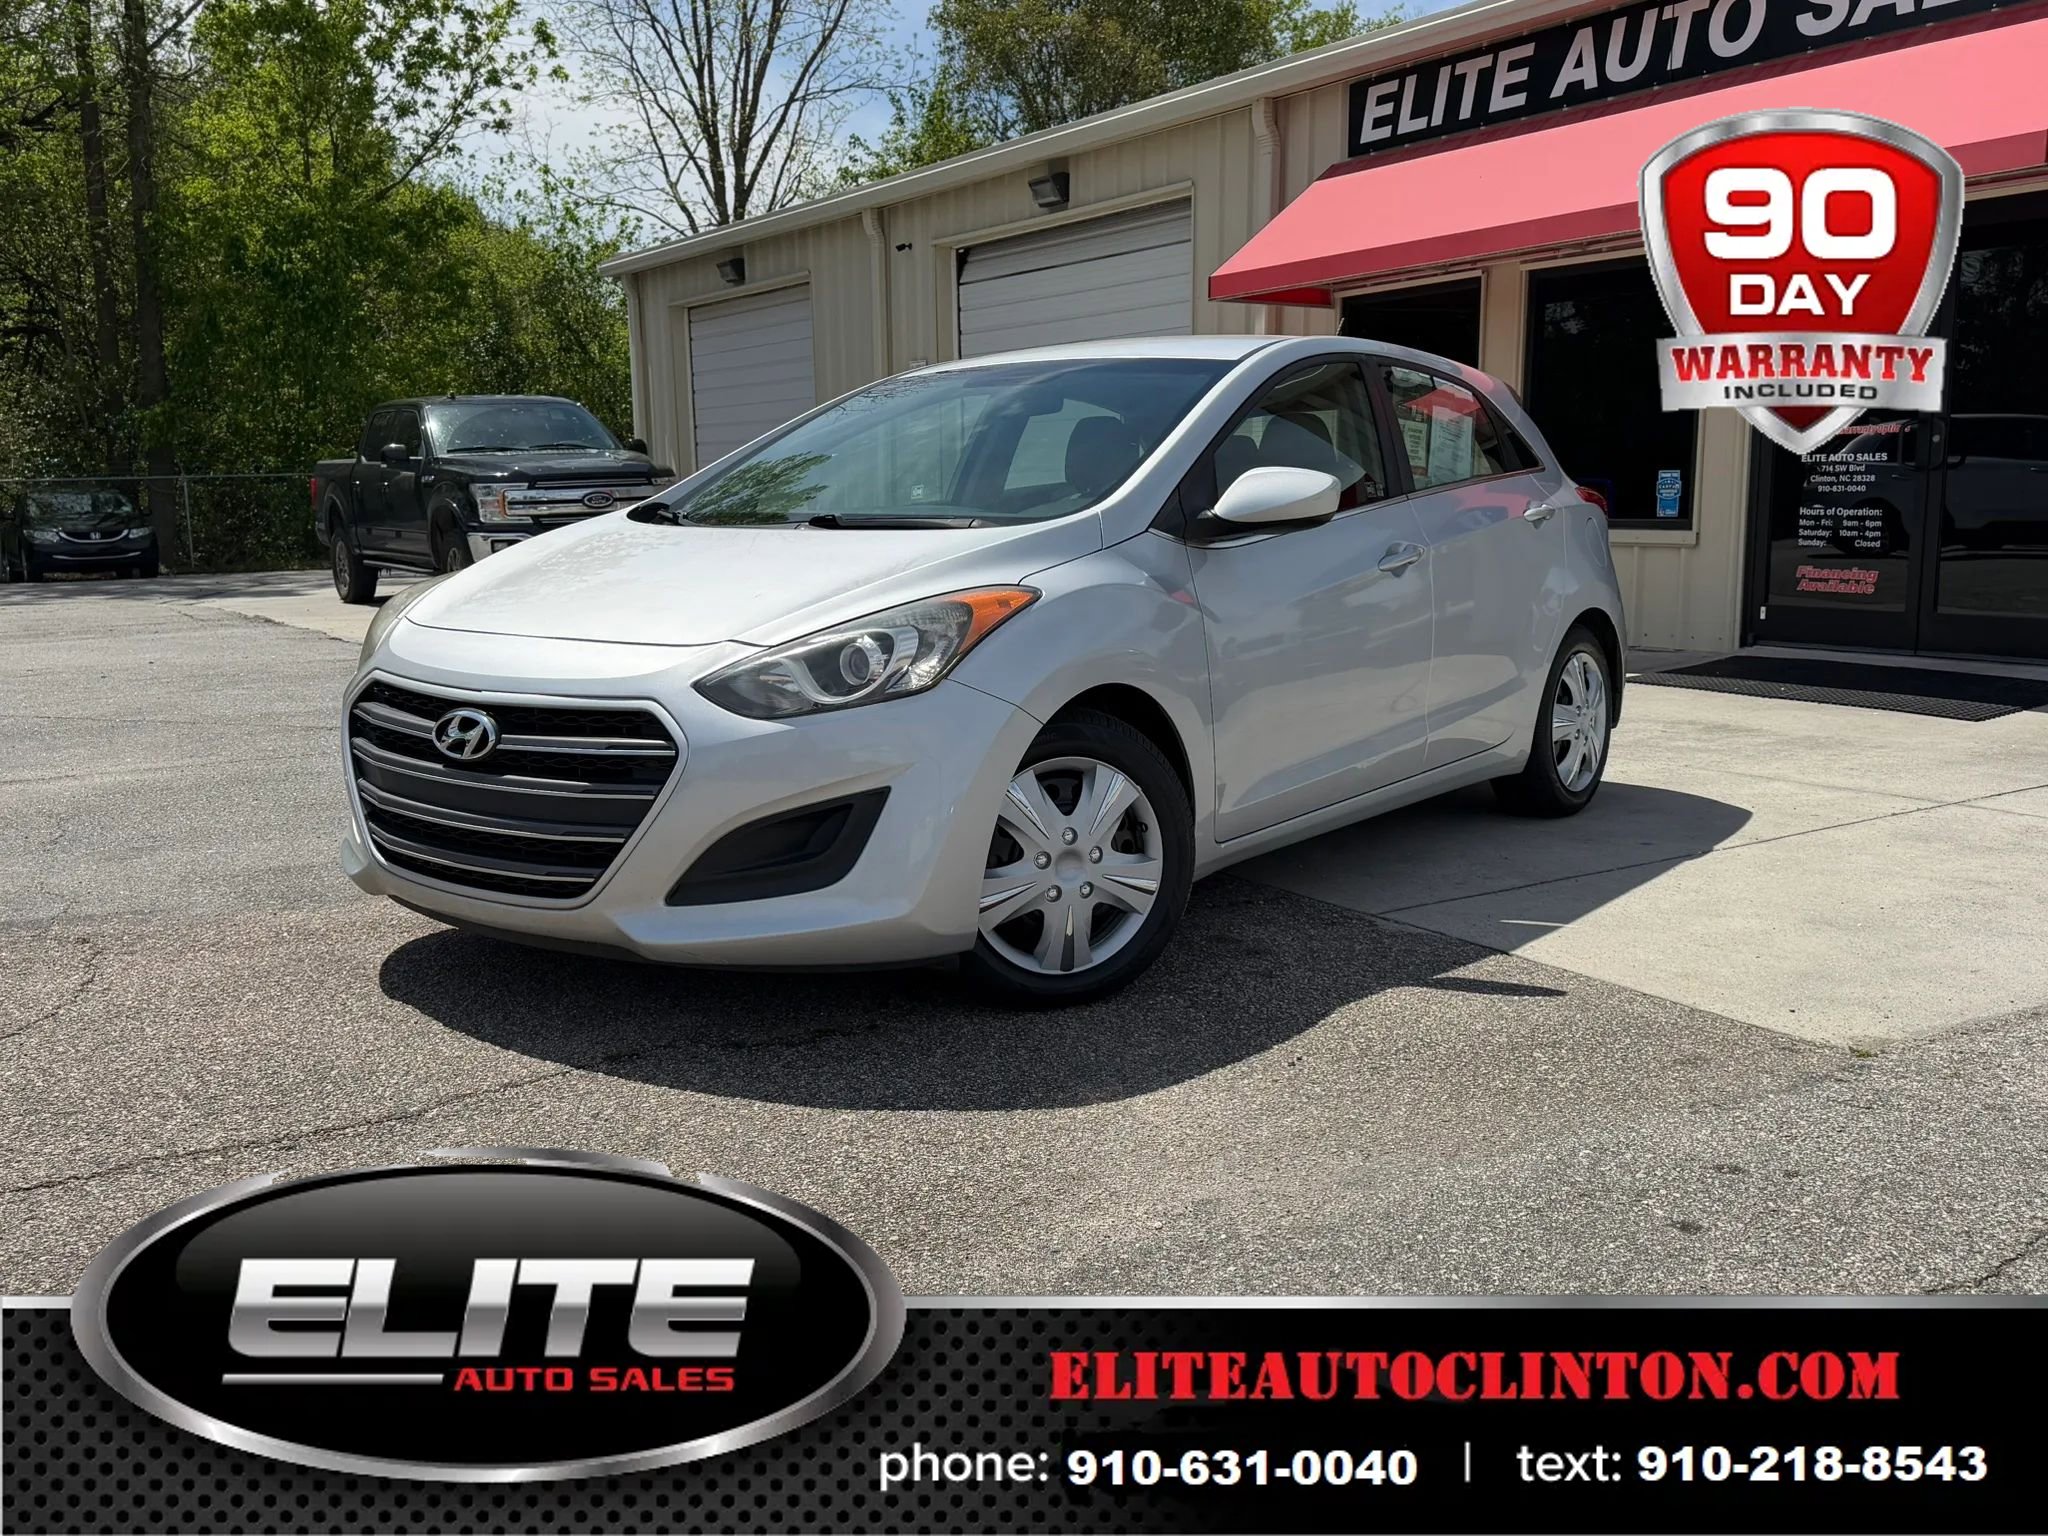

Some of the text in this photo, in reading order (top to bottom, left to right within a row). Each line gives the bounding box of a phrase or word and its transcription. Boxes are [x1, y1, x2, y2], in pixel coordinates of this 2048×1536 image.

[1360, 0, 1767, 144] ELITE AUTO
[1801, 453, 1888, 462] ELITE AUTO SALES
[1849, 464, 1866, 472] Blvd
[1800, 507, 1883, 517] Hours of Operation:
[1865, 520, 1882, 528] 6pm
[1798, 529, 1832, 538] Saturday:
[1865, 530, 1881, 538] 4pm
[1798, 539, 1827, 547] Sunday:
[1796, 565, 1880, 583] Financing
[1796, 579, 1875, 595] Available
